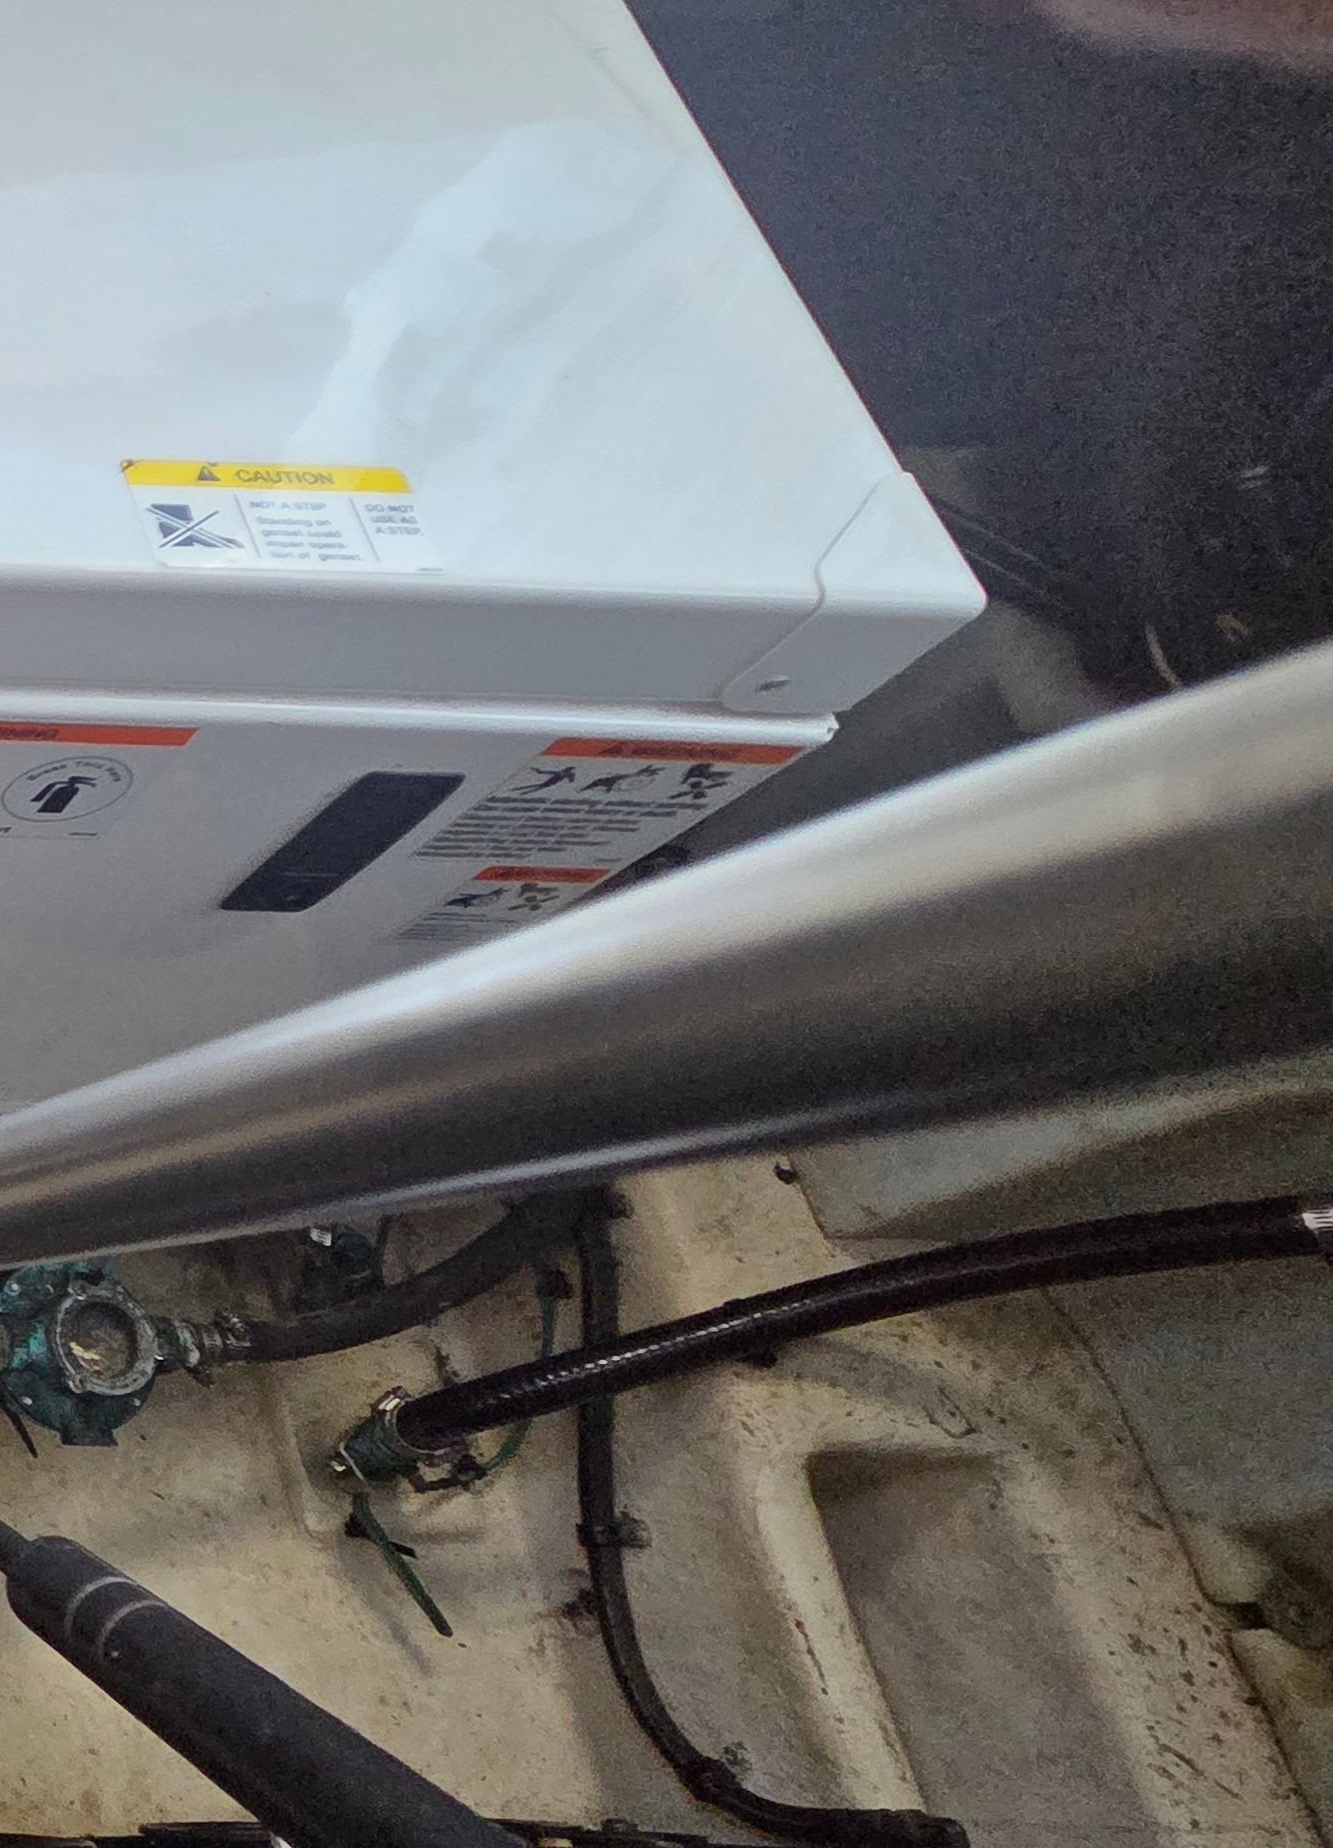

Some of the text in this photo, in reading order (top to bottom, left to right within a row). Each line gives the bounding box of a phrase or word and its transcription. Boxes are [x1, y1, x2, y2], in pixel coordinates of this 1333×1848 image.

[236, 469, 333, 484] CAUTION
[249, 501, 276, 509] NOT
[294, 503, 326, 511] STEP
